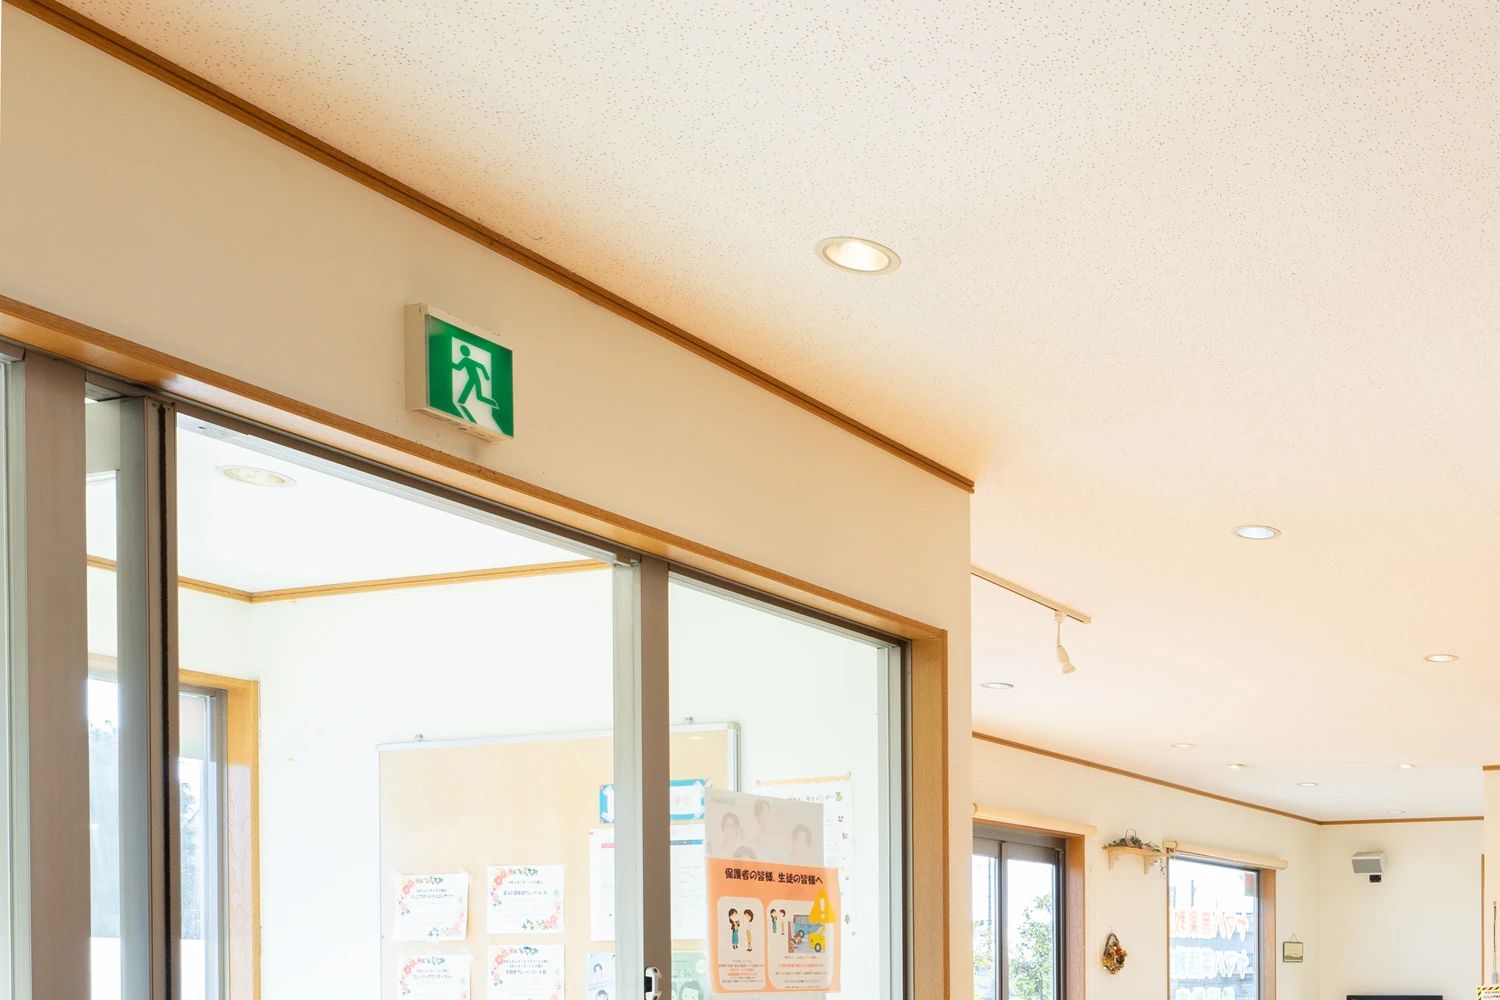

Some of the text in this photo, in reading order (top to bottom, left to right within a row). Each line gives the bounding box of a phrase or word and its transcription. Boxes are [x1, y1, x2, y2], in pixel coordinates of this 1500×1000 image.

[725, 867, 824, 885] 保護者の皆様、生徒の皆様へ
